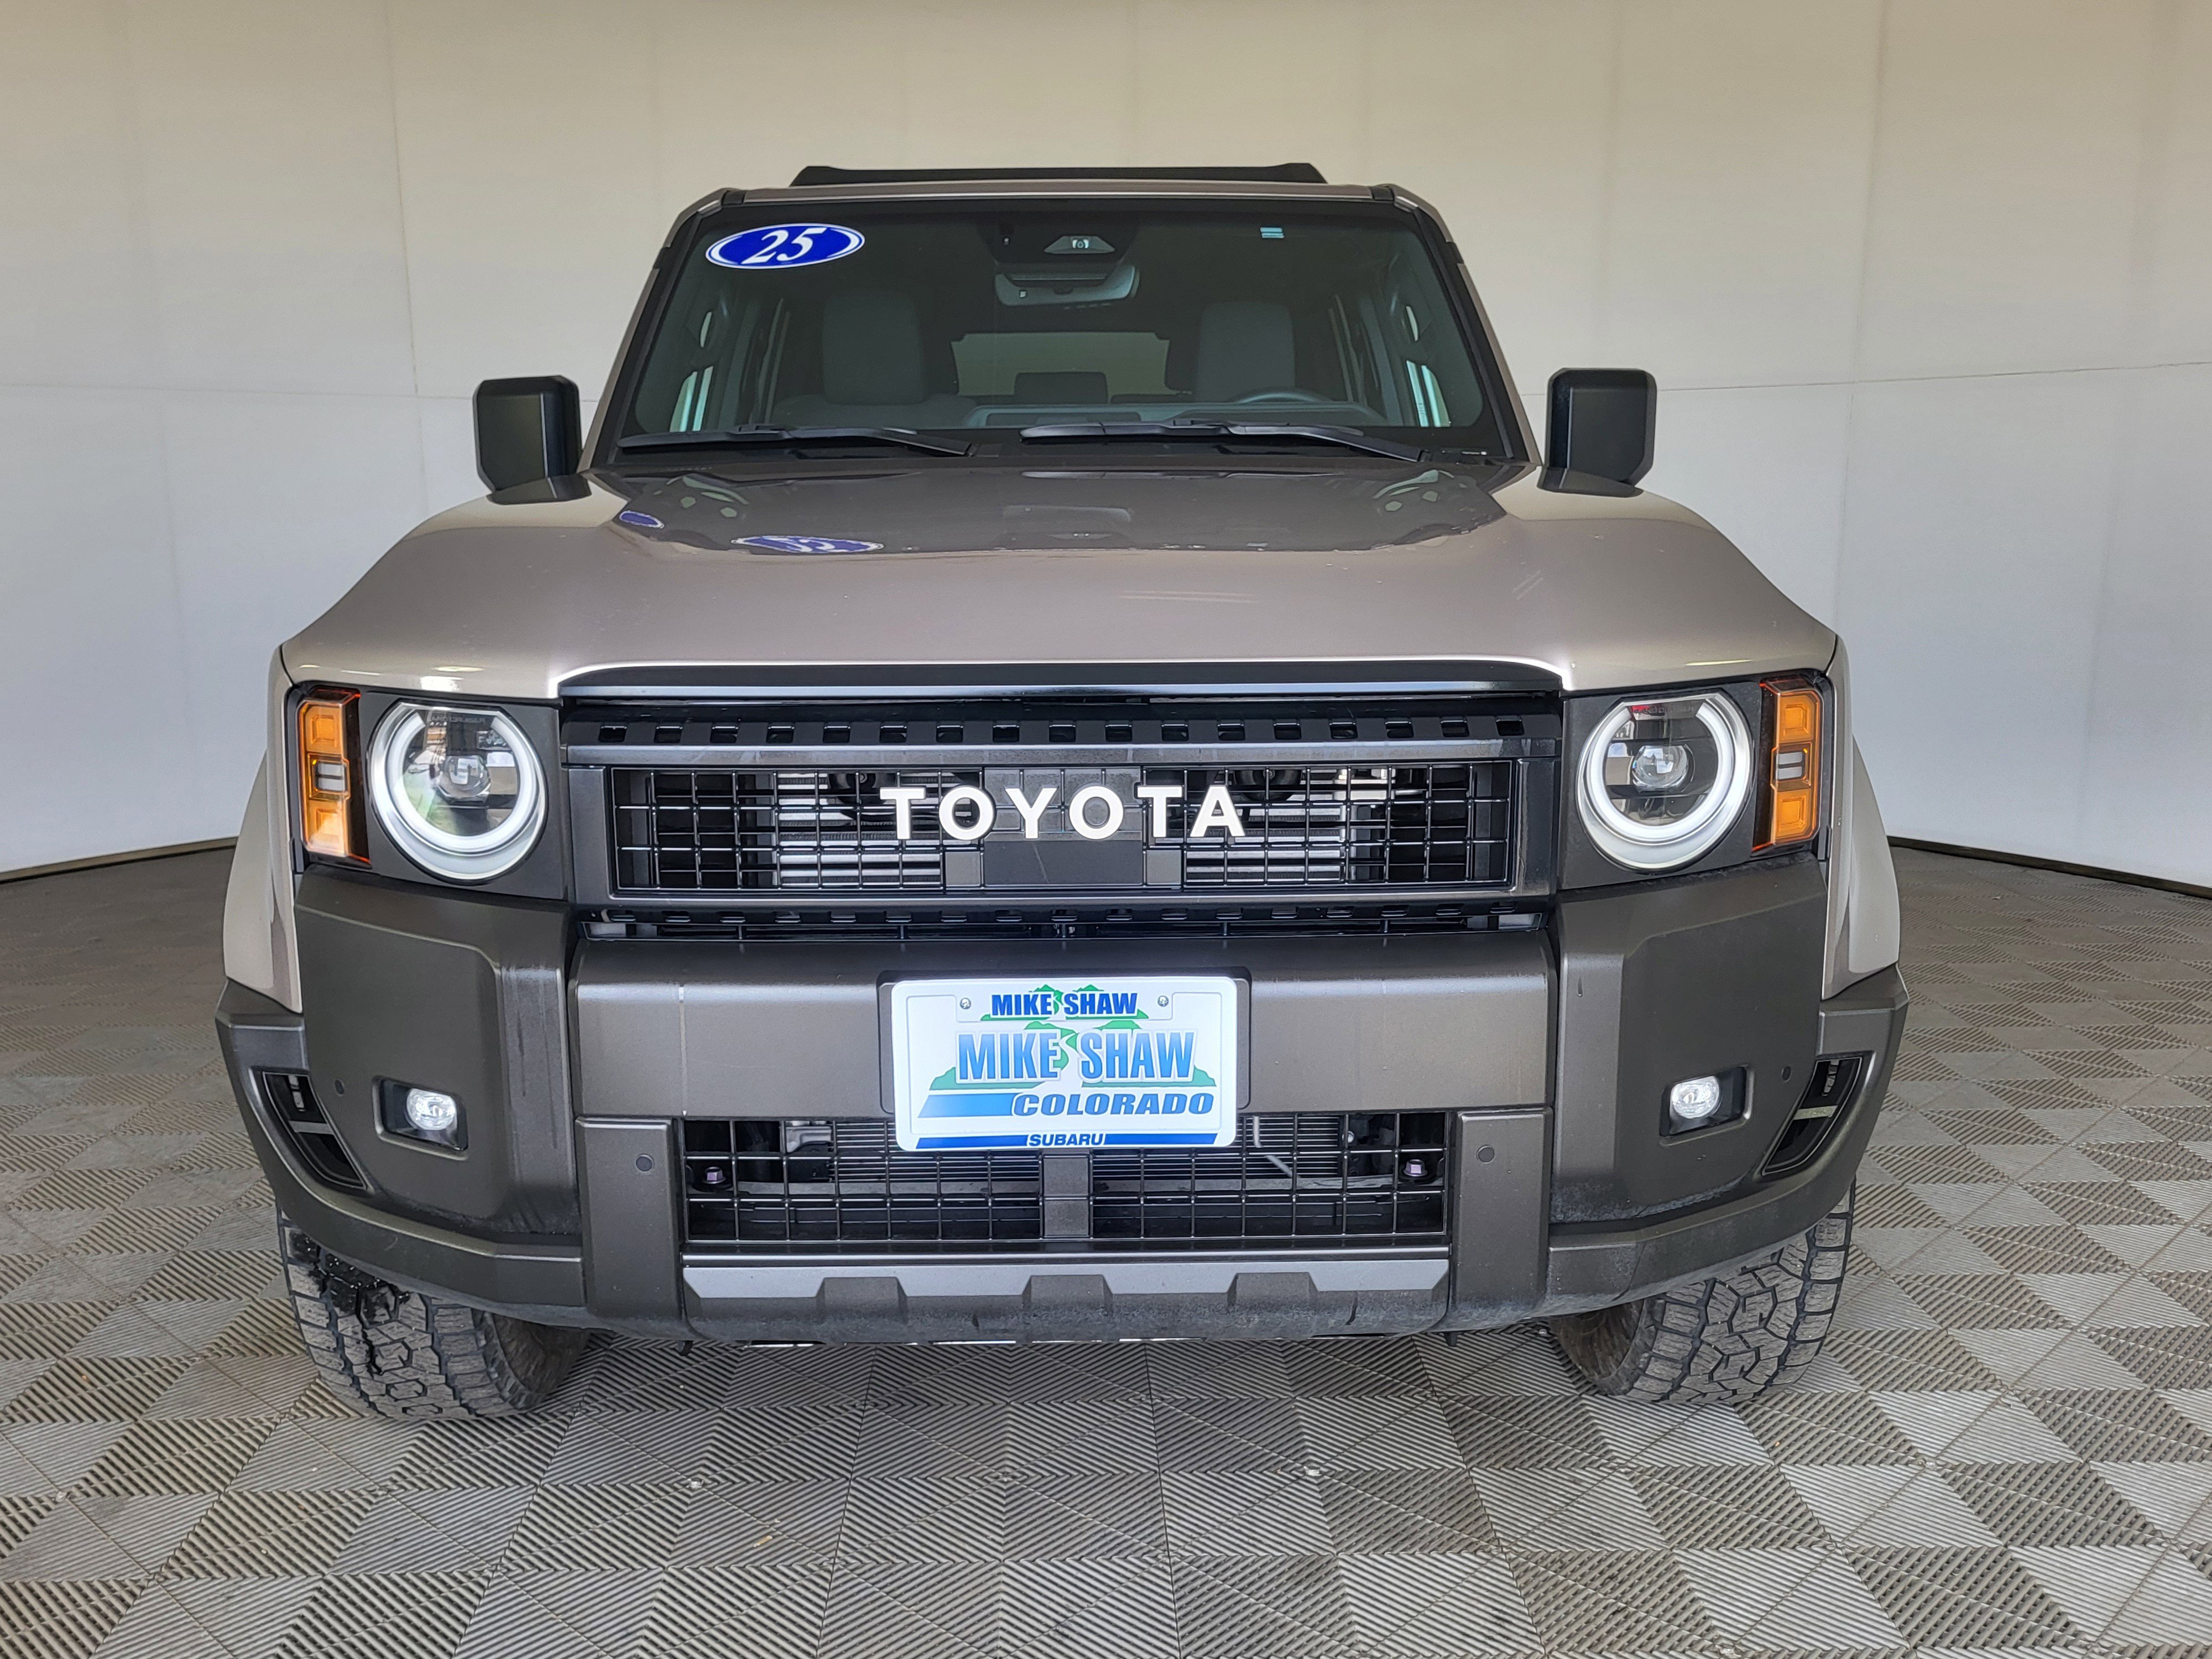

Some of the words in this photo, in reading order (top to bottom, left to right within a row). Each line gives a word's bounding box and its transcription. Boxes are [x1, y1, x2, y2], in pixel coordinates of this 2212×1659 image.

[740, 227, 827, 264] 25
[879, 785, 1246, 840] TOYOTA
[992, 994, 1052, 1016] MIKE
[1063, 992, 1138, 1015] SHAW
[958, 1032, 1058, 1080] MIKE
[1080, 1031, 1195, 1079] SHAW
[1014, 1093, 1214, 1116] COLORADO
[1029, 1134, 1104, 1146] SUBARU
